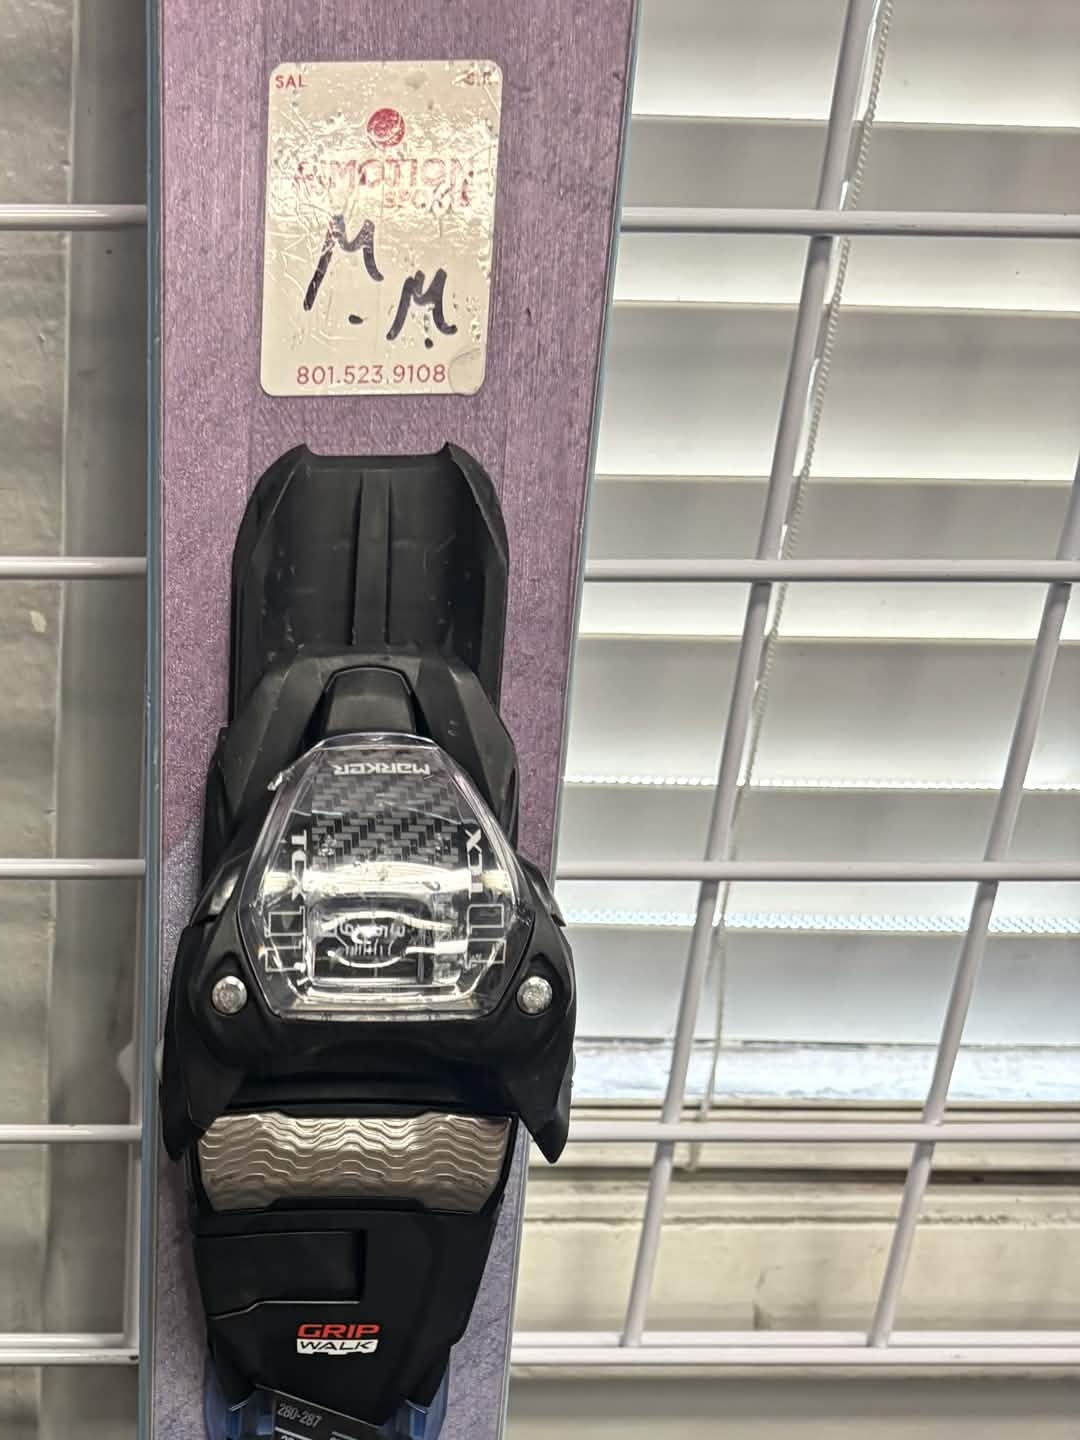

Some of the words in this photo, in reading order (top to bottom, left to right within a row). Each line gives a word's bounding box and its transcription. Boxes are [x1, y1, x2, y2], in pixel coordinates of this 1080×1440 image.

[275, 74, 307, 89] SAL
[296, 364, 446, 386] 801.523.9108
[333, 763, 431, 777] MARKER
[297, 1324, 381, 1339] GRIP
[299, 1340, 374, 1351] WALK
